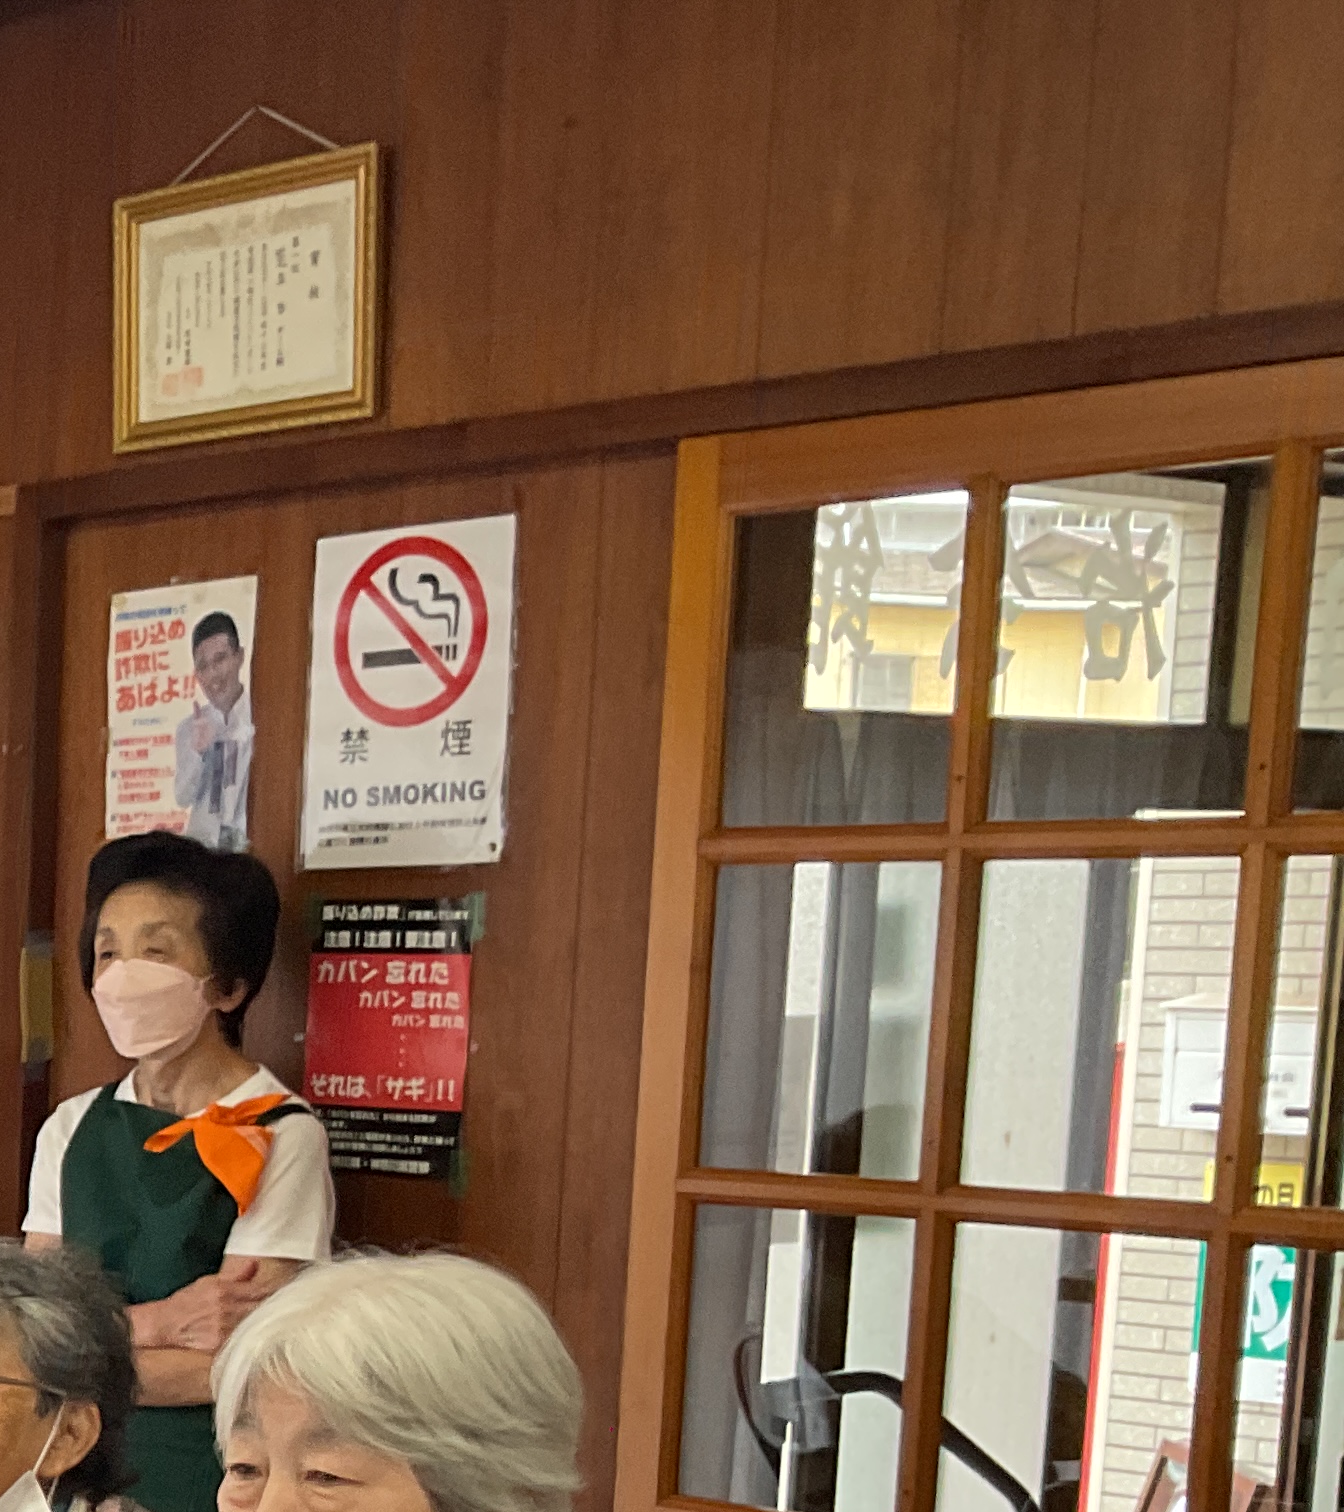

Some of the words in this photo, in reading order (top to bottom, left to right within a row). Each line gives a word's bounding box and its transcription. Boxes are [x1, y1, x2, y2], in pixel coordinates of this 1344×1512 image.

[323, 788, 358, 811] NO
[366, 779, 487, 808] SMOKING
[317, 959, 379, 984] カバン
[385, 960, 450, 985] 忘れた
[359, 989, 406, 1008] カバン
[411, 989, 461, 1009] 忘れた
